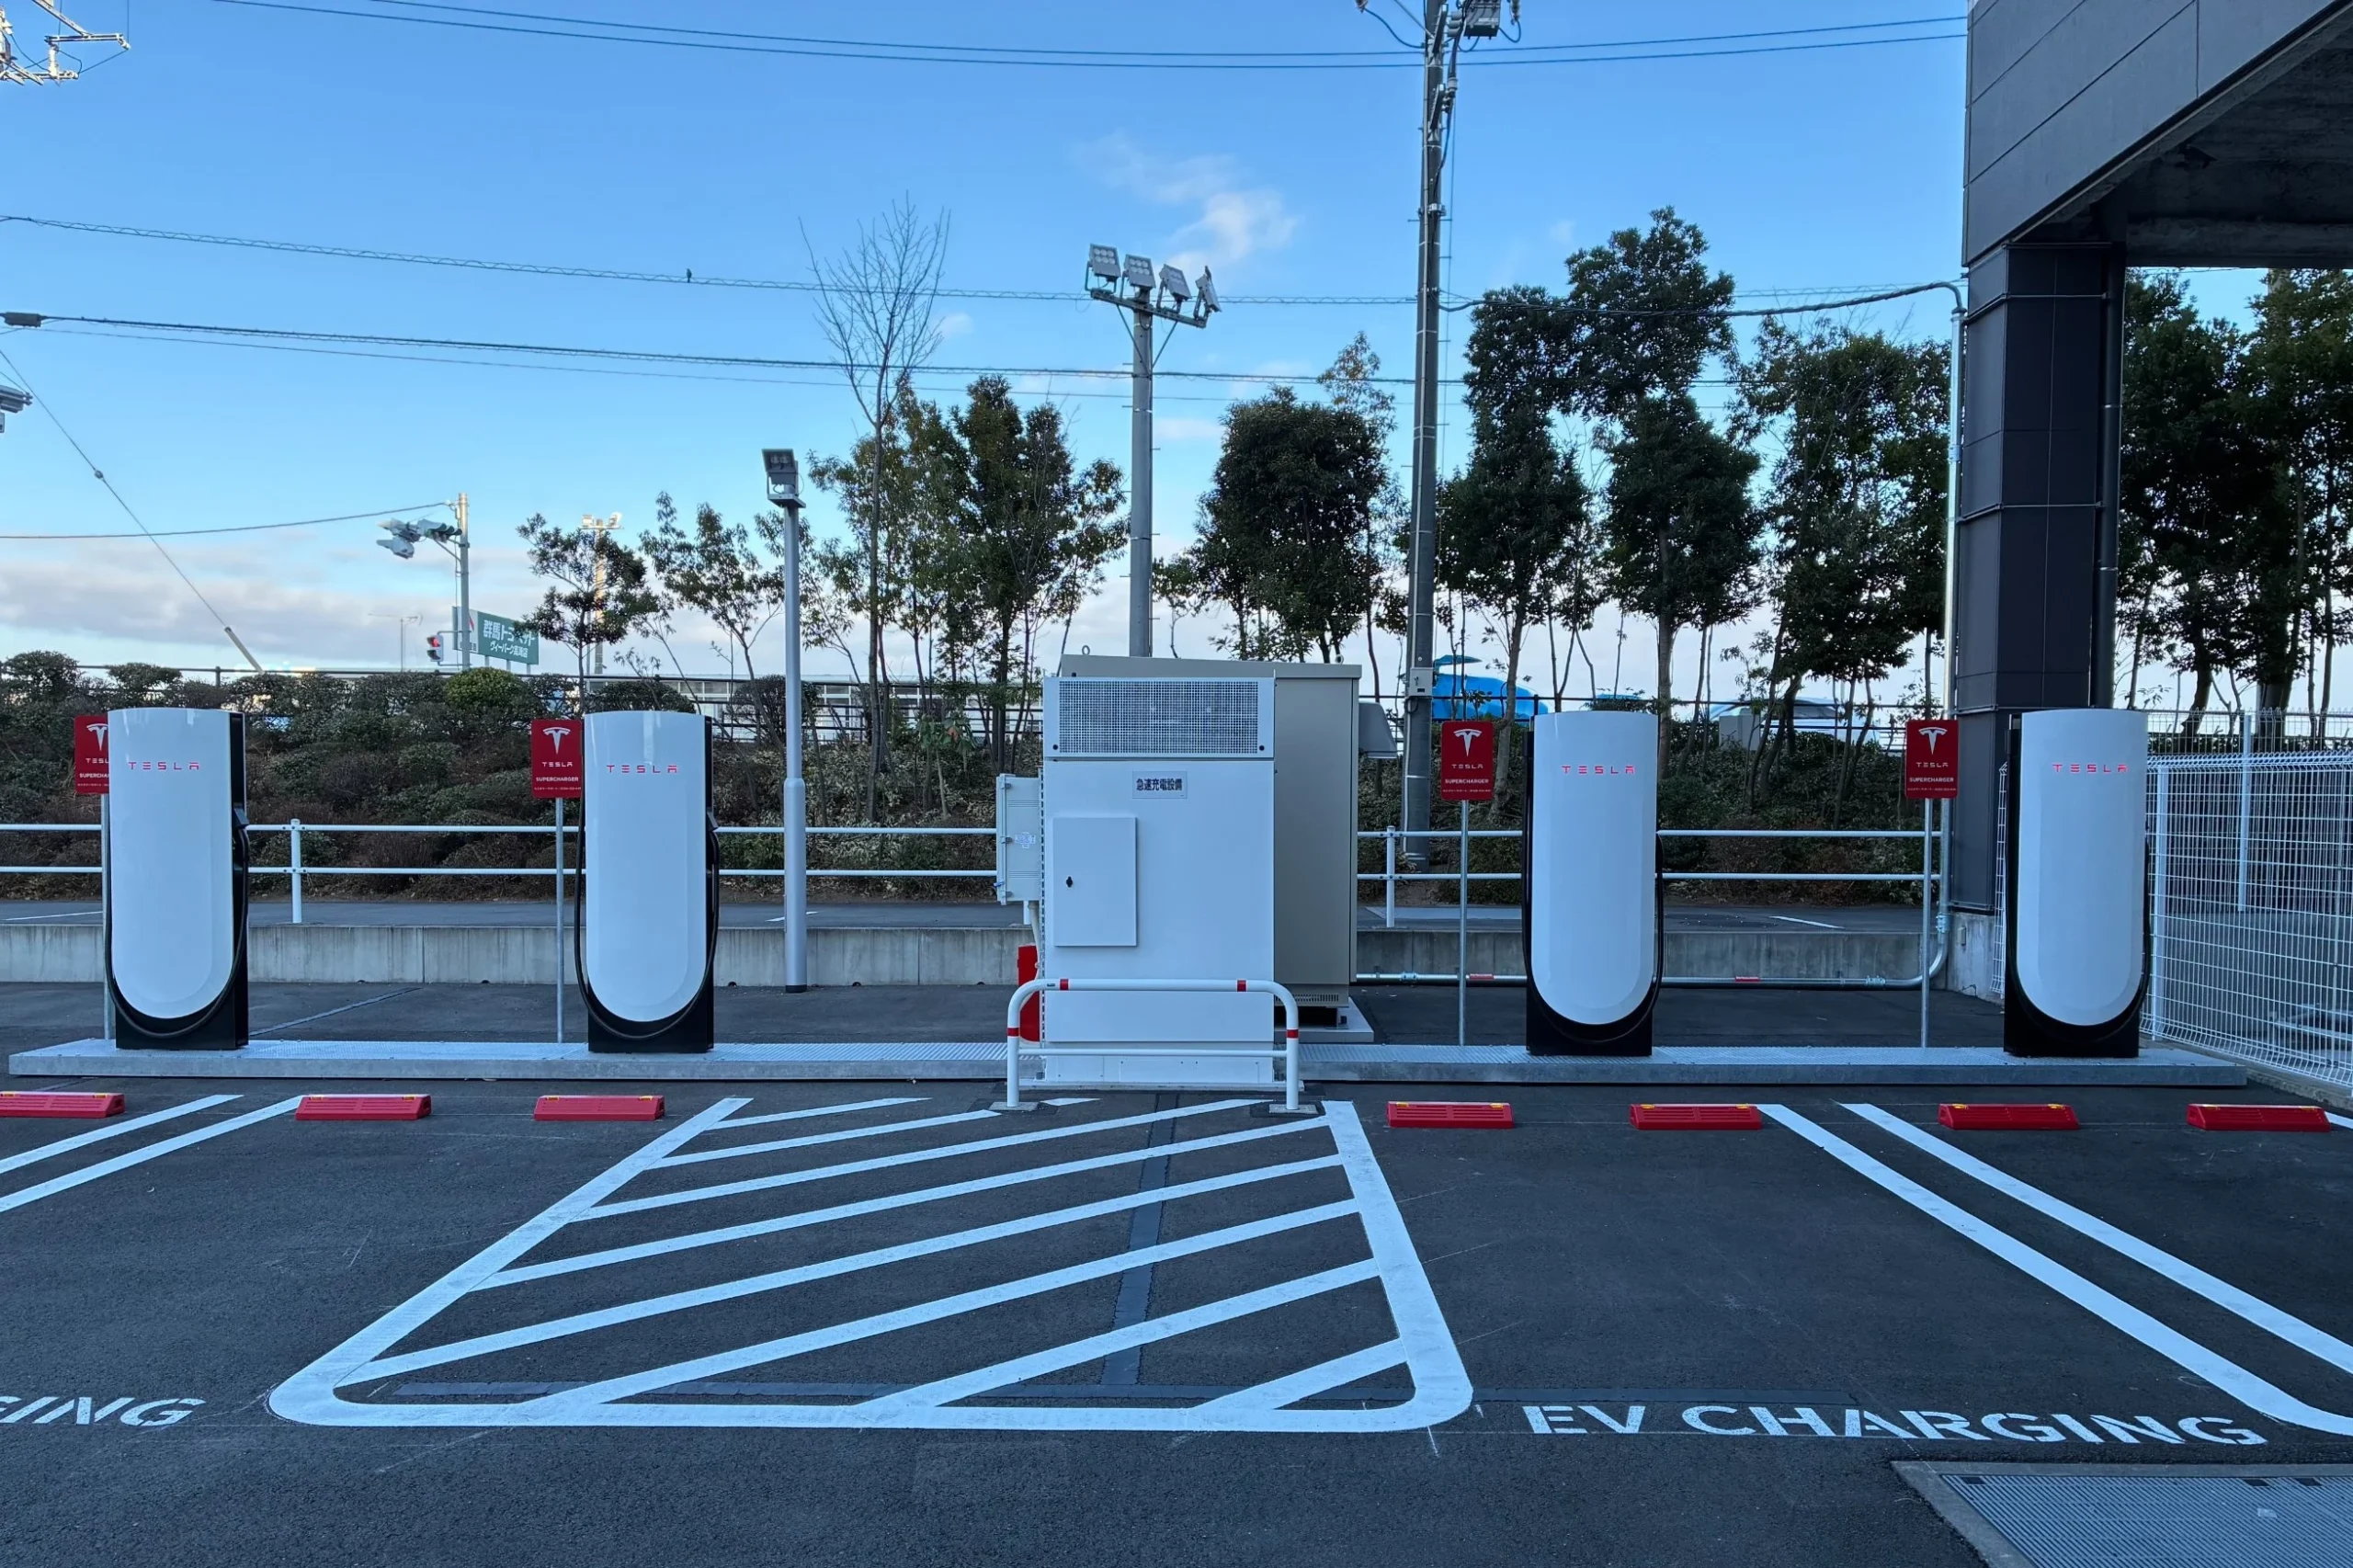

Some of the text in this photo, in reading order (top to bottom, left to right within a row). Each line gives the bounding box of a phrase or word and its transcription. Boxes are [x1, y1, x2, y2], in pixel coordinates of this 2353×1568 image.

[128, 761, 199, 770] TESLA
[606, 765, 677, 774] TESLA
[1561, 765, 1634, 774] TESLA
[2052, 764, 2127, 773] TESLA
[1136, 778, 1183, 791] 急速充電設備
[0, 1396, 207, 1426] ING
[1523, 1404, 2269, 1445] EV CHARGING
